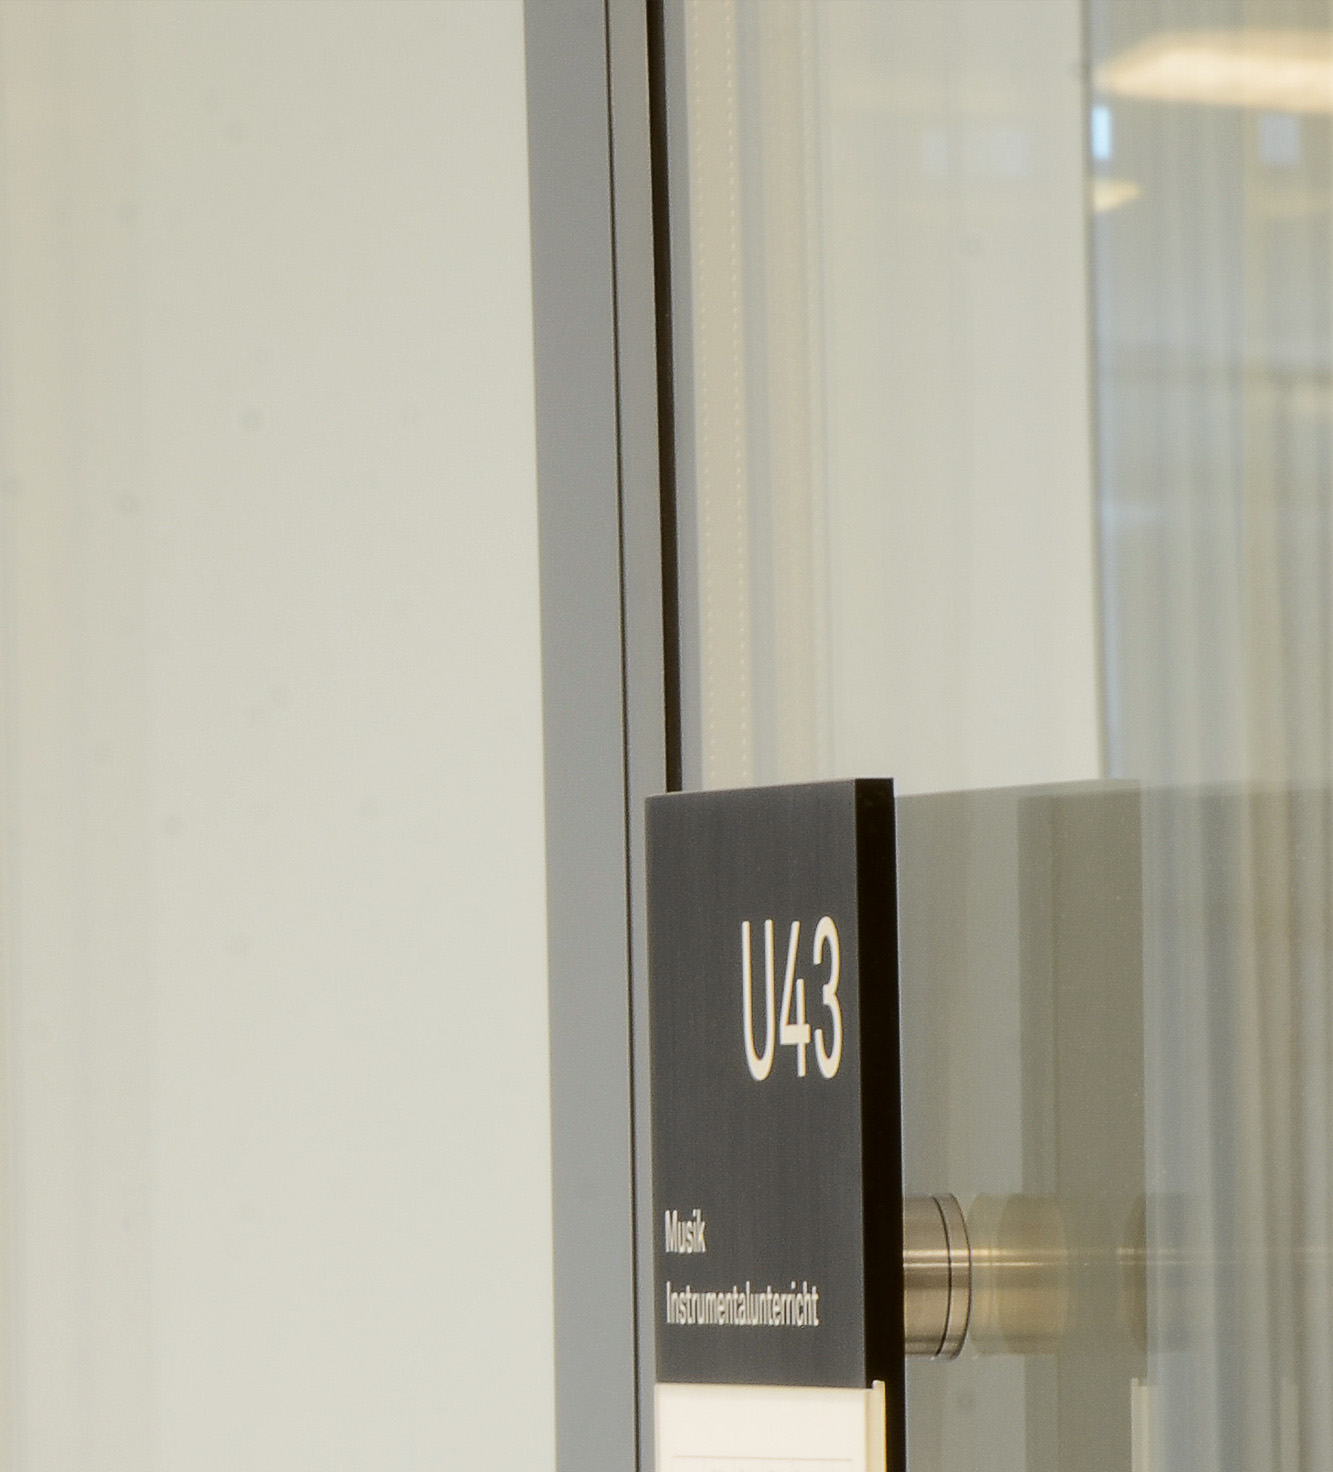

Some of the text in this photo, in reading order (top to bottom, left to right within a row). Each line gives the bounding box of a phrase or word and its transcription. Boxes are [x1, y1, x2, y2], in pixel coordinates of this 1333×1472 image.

[742, 916, 842, 1081] U43
[665, 1209, 706, 1253] Musik
[666, 1281, 819, 1326] Instrumentalunterricht
